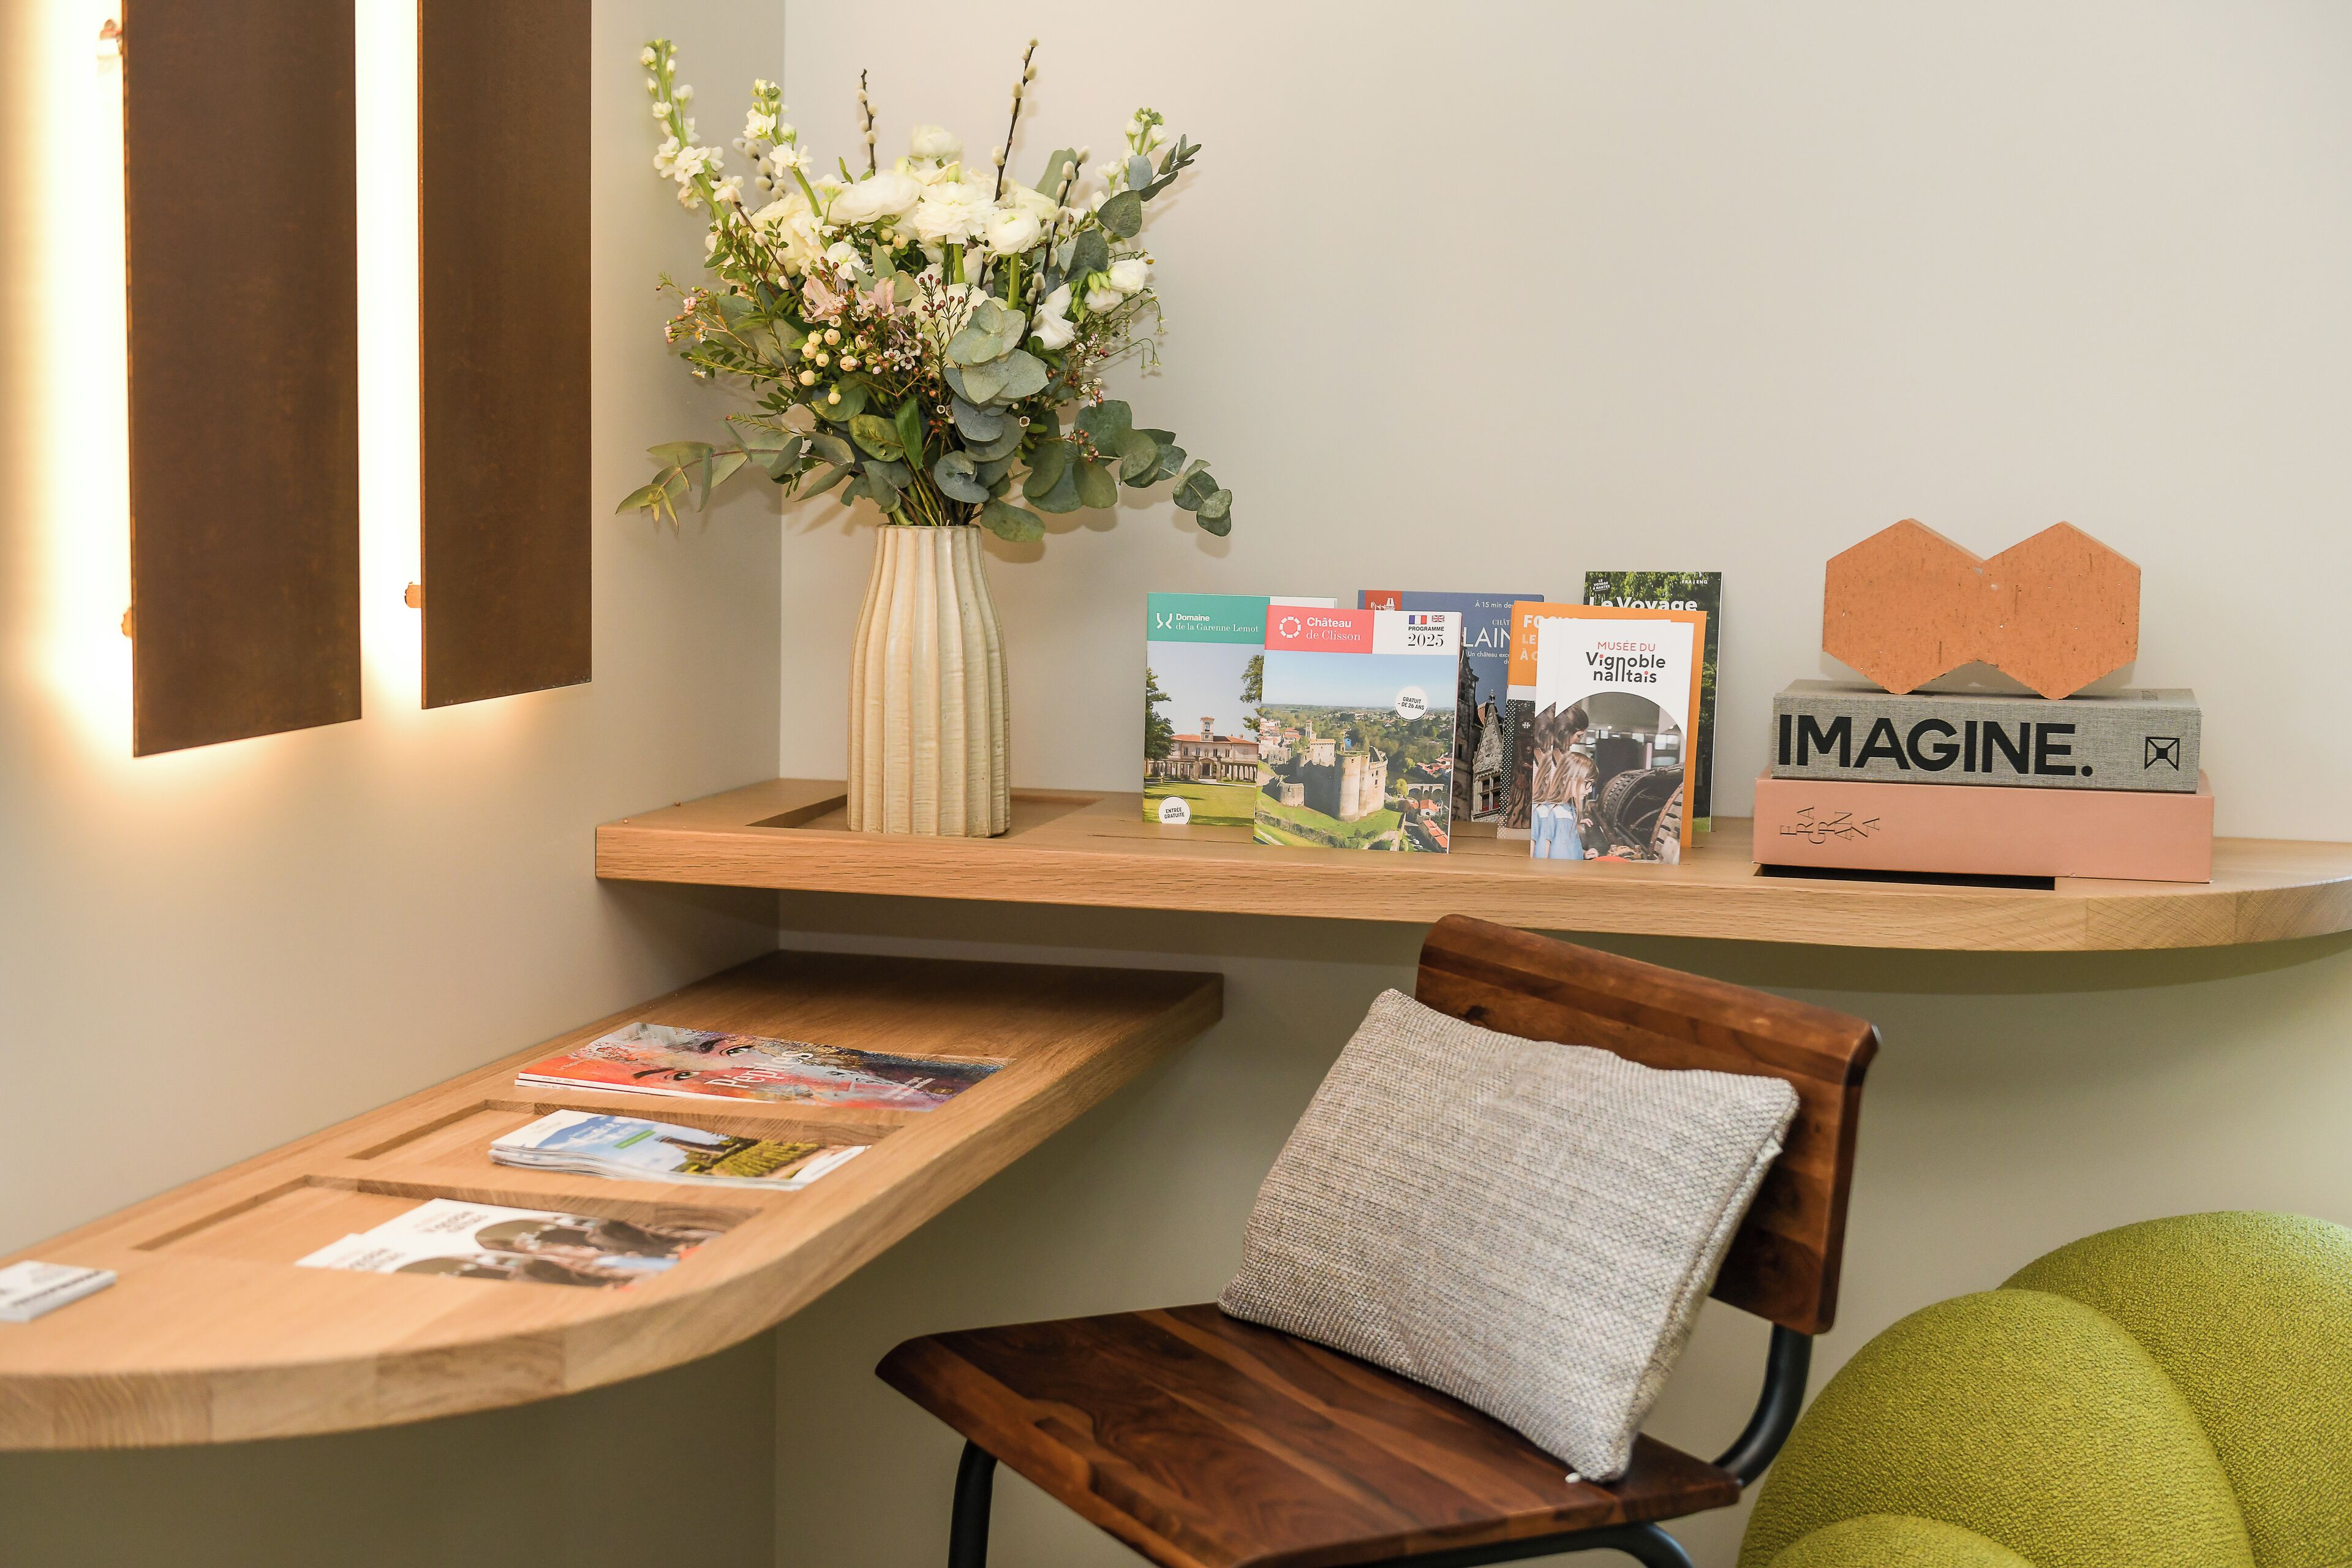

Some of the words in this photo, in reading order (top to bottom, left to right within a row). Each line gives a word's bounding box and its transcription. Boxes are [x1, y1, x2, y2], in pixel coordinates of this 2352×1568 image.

[1475, 599, 1480, 608] À
[1616, 596, 1698, 611] Voyage
[1306, 617, 1352, 628] Château
[1306, 629, 1319, 639] de
[1322, 629, 1361, 641] Clisson
[1408, 633, 1444, 647] 2025
[1463, 627, 1510, 648] LAIN
[1521, 633, 1537, 645] LE
[1597, 640, 1637, 651] MUSÉE
[1639, 643, 1656, 652] DU
[1520, 647, 1529, 661] À
[1586, 652, 1666, 670] Vignoble
[1778, 714, 2093, 777] IMAGINE.
[704, 1051, 813, 1089] Pépites
